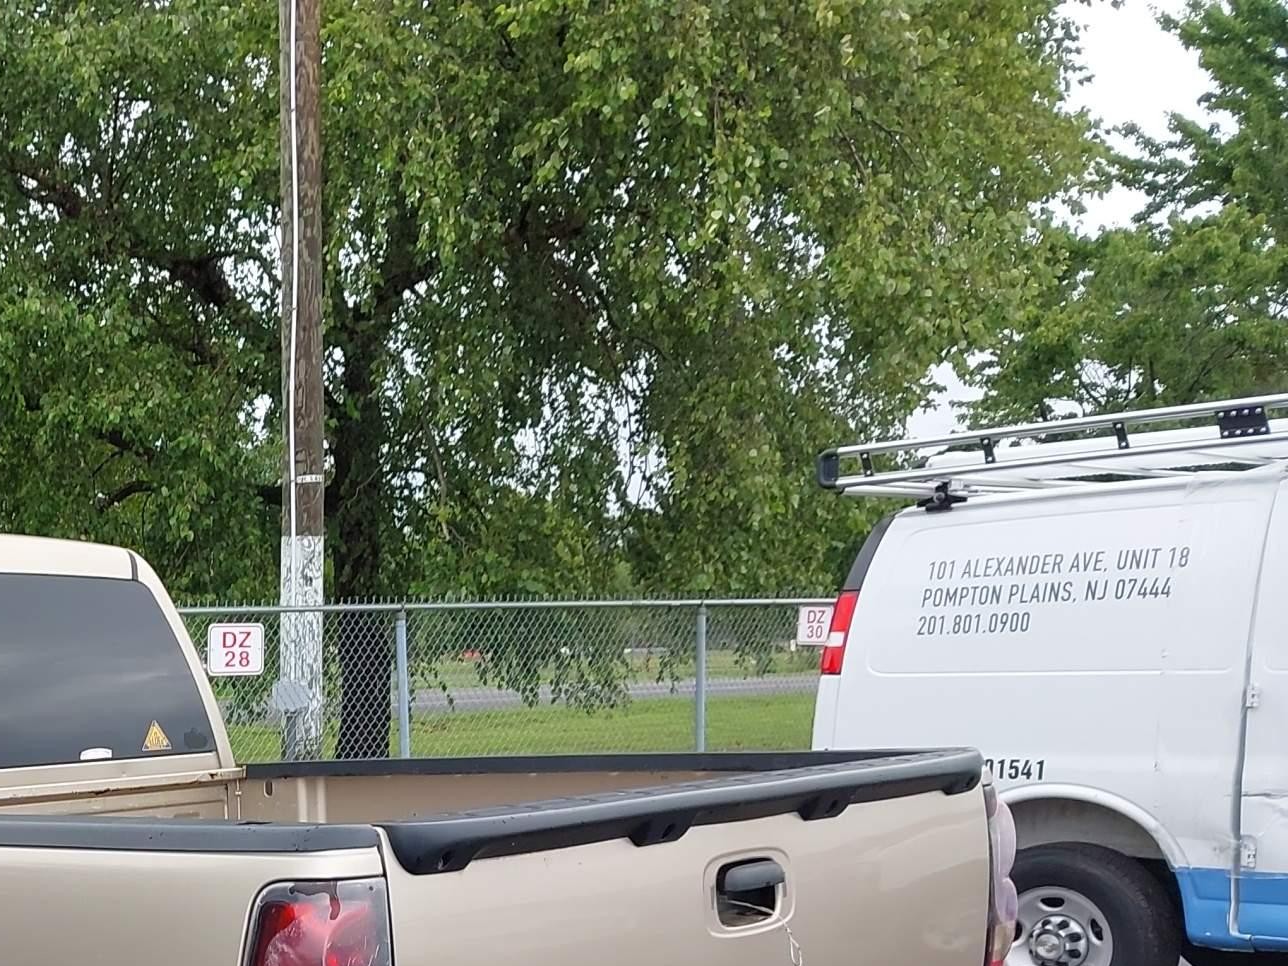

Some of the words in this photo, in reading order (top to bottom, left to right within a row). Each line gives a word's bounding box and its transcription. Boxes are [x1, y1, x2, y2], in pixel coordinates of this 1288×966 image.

[928, 560, 957, 581] 101
[961, 553, 1064, 579] ALEXANDER
[1068, 550, 1108, 574] AVE,
[1116, 547, 1162, 571] UNIT
[1167, 546, 1191, 569] 18
[920, 584, 1003, 608] POMPTON
[1007, 580, 1077, 605] PLAINS,
[1084, 578, 1109, 601] NJ
[1114, 576, 1172, 600] 07444
[806, 609, 826, 624] DZ
[916, 611, 1031, 636] 201.801.0900
[222, 631, 252, 649] DZ
[806, 625, 823, 639] 30
[224, 650, 250, 668] 28
